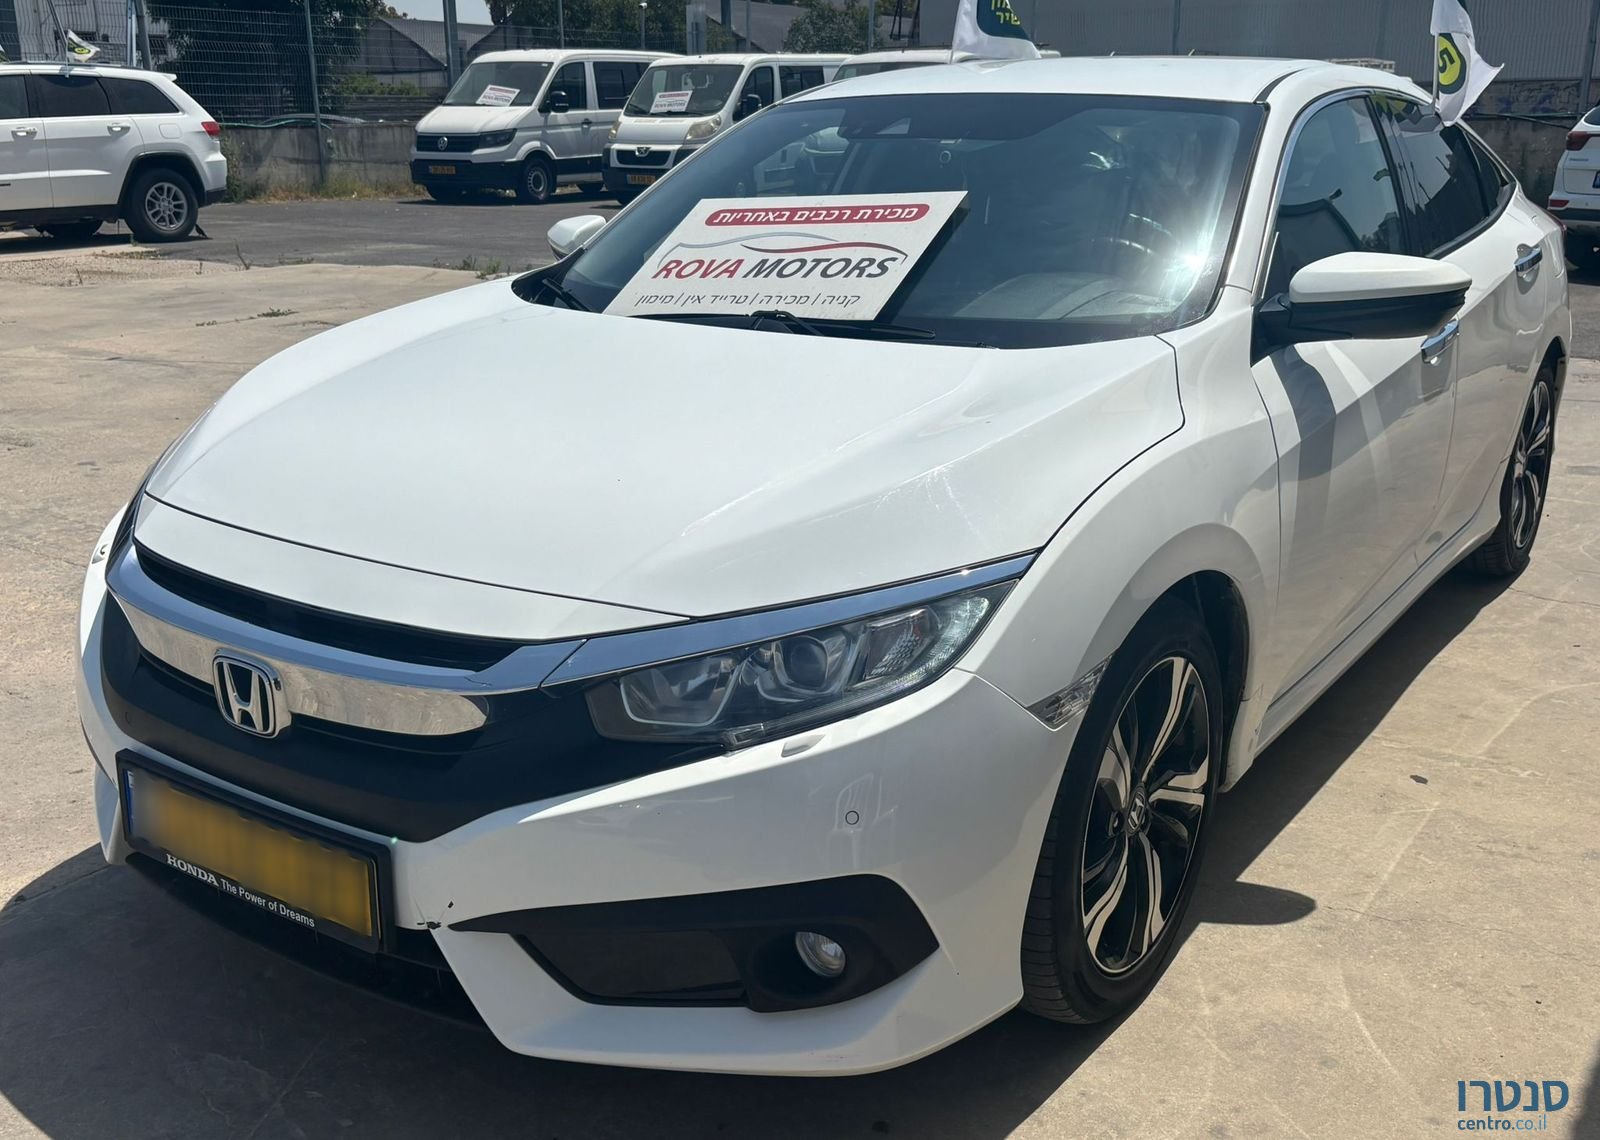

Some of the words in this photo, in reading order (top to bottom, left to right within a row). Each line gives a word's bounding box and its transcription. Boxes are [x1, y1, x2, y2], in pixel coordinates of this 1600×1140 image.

[713, 211, 788, 223] באחריות
[792, 209, 849, 222] רכבים
[853, 207, 918, 220] מכירת
[651, 258, 744, 280] ROVA
[741, 257, 898, 280] MOTORS
[634, 294, 675, 307] מימון
[681, 294, 705, 307] אין
[710, 294, 749, 305] טרייד
[758, 294, 810, 305] מכירה
[821, 295, 861, 308] קניה
[165, 853, 220, 887] HONDA
[220, 878, 237, 895] The
[238, 886, 266, 907] Power
[267, 900, 278, 913] of
[279, 905, 316, 928] Dreams
